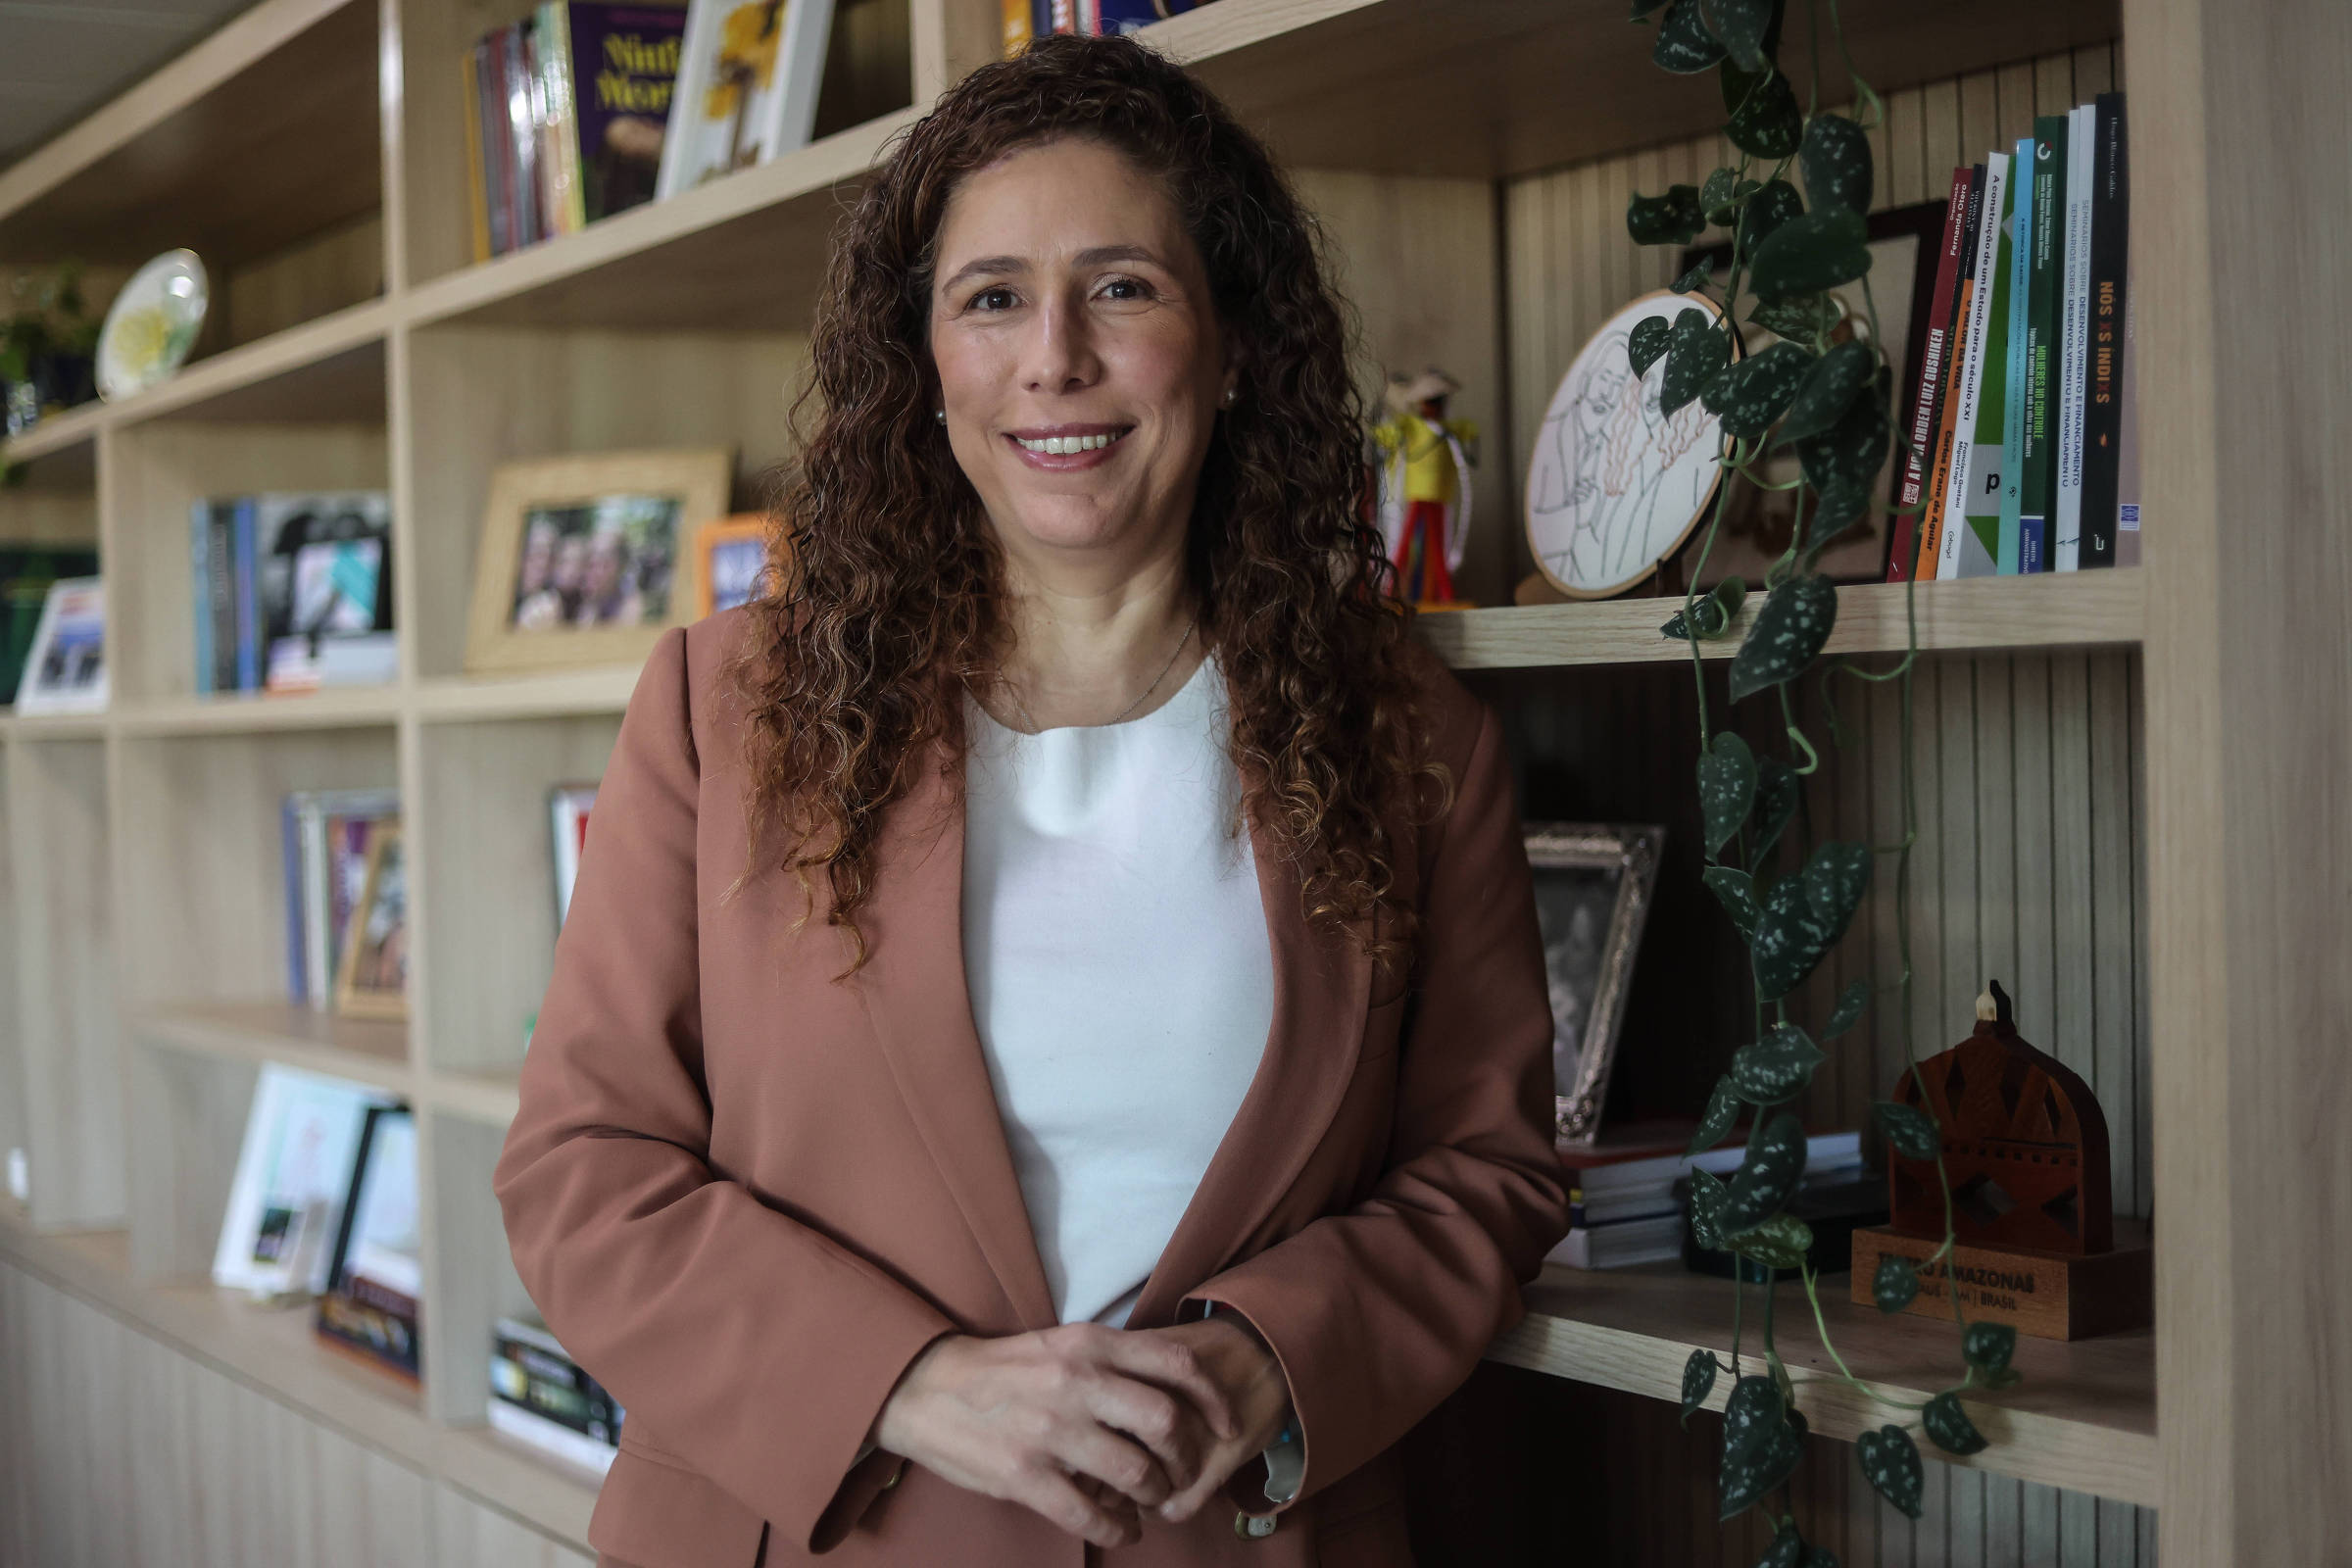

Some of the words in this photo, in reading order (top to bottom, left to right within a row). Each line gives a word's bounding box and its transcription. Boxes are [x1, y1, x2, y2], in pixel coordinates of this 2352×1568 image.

[1992, 174, 2000, 183] A
[1950, 183, 1959, 220] Organização
[1985, 185, 1997, 250] construção
[1949, 213, 1963, 256] Fernanda
[1958, 184, 1967, 211] Otero
[1981, 268, 1987, 285] um
[1983, 252, 1990, 266] de
[2080, 261, 2088, 292] SOBRE
[2068, 264, 2077, 296] SOBRE
[1976, 287, 1986, 326] Estado
[2099, 281, 2115, 316] NÓS
[1926, 328, 1944, 380] GUSHIKEN
[1972, 327, 1981, 353] para
[2065, 299, 2075, 396] DESENVOLVIMENTO
[2076, 296, 2086, 393] DESENVOLVIMENTO
[1953, 365, 1963, 389] VIDA
[1965, 364, 1976, 400] século
[2034, 345, 2046, 386] MULHERES
[1921, 382, 1936, 406] LUIZ
[2034, 387, 2045, 399] NO
[1915, 407, 1933, 442] ORDEM
[1963, 402, 1972, 420] XXI
[2034, 400, 2044, 439] CONTROLE
[1942, 430, 1952, 464] Carlos
[1960, 442, 1969, 477] Francisco
[2073, 404, 2082, 486] FINANCIAMENTO
[1932, 500, 1941, 514] de
[1928, 515, 1938, 552] Aguiar
[1939, 1261, 2034, 1293] AMAZONAS
[1981, 1293, 2017, 1310] BRASIL
